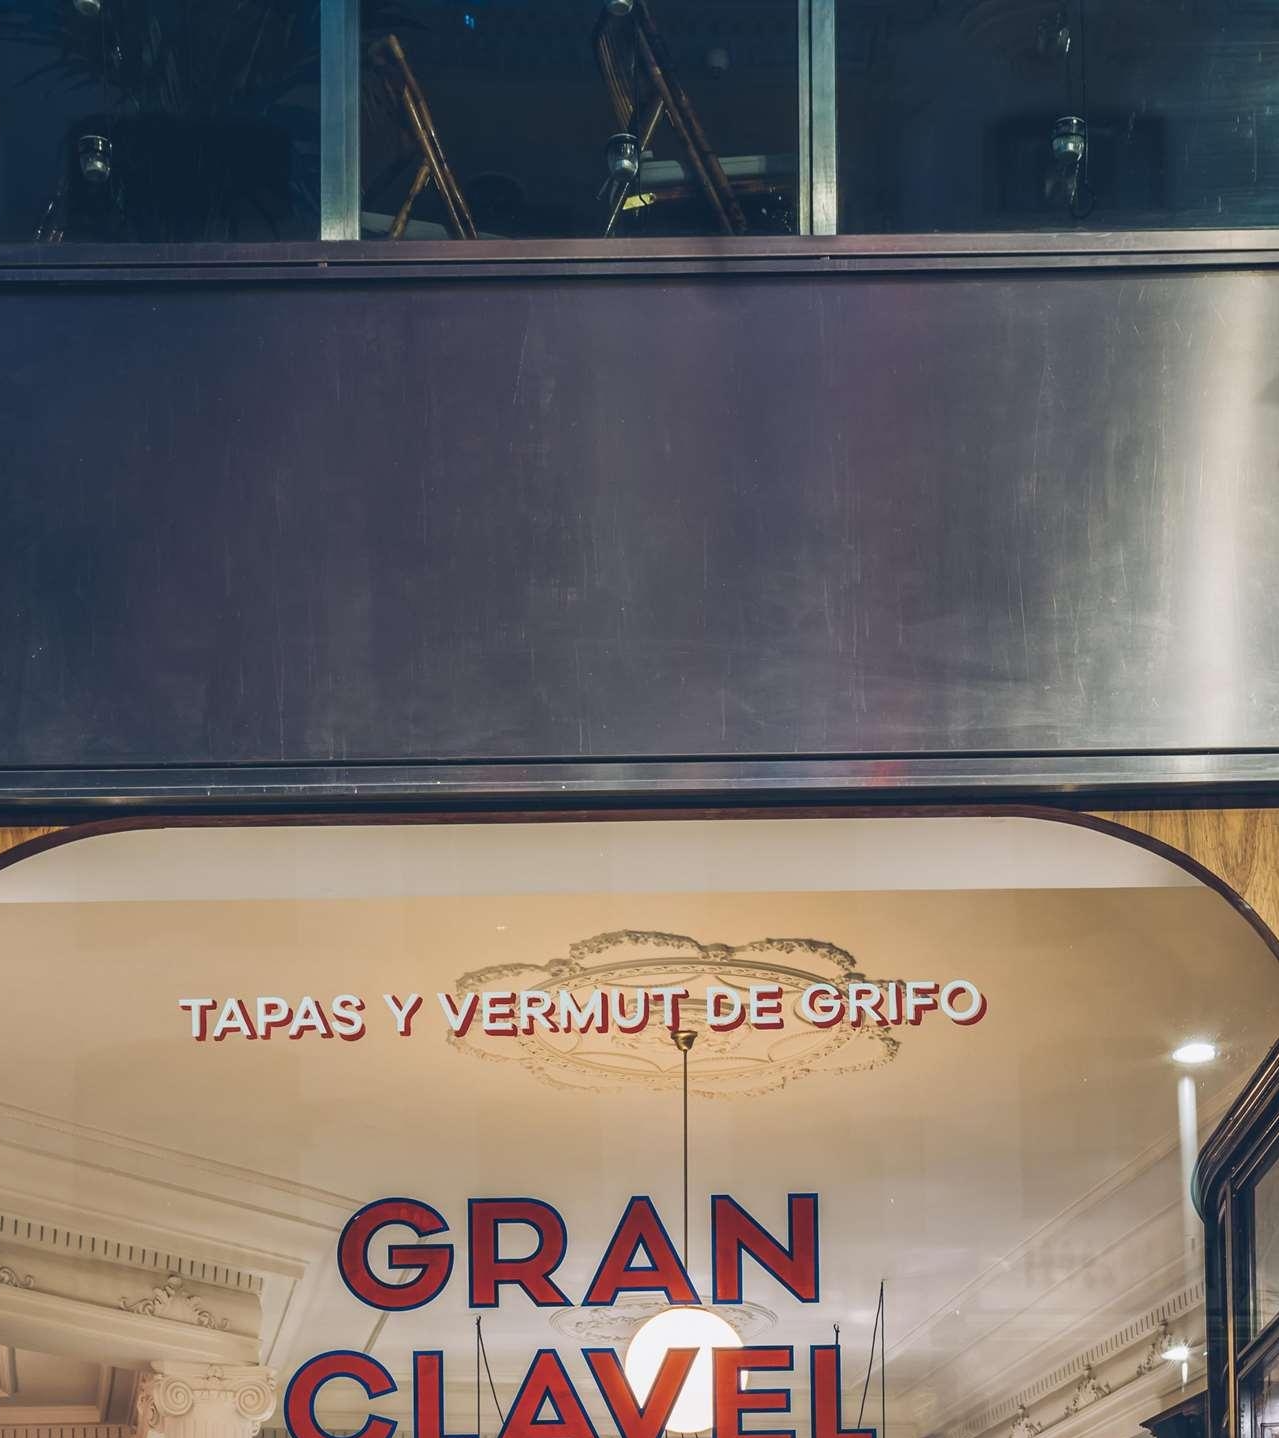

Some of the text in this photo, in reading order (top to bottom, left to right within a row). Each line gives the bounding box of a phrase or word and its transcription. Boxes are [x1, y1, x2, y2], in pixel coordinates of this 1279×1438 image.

[178, 979, 987, 1041] TAPAS Y VERMUT DE GRIFO
[337, 1192, 819, 1312] GRAN
